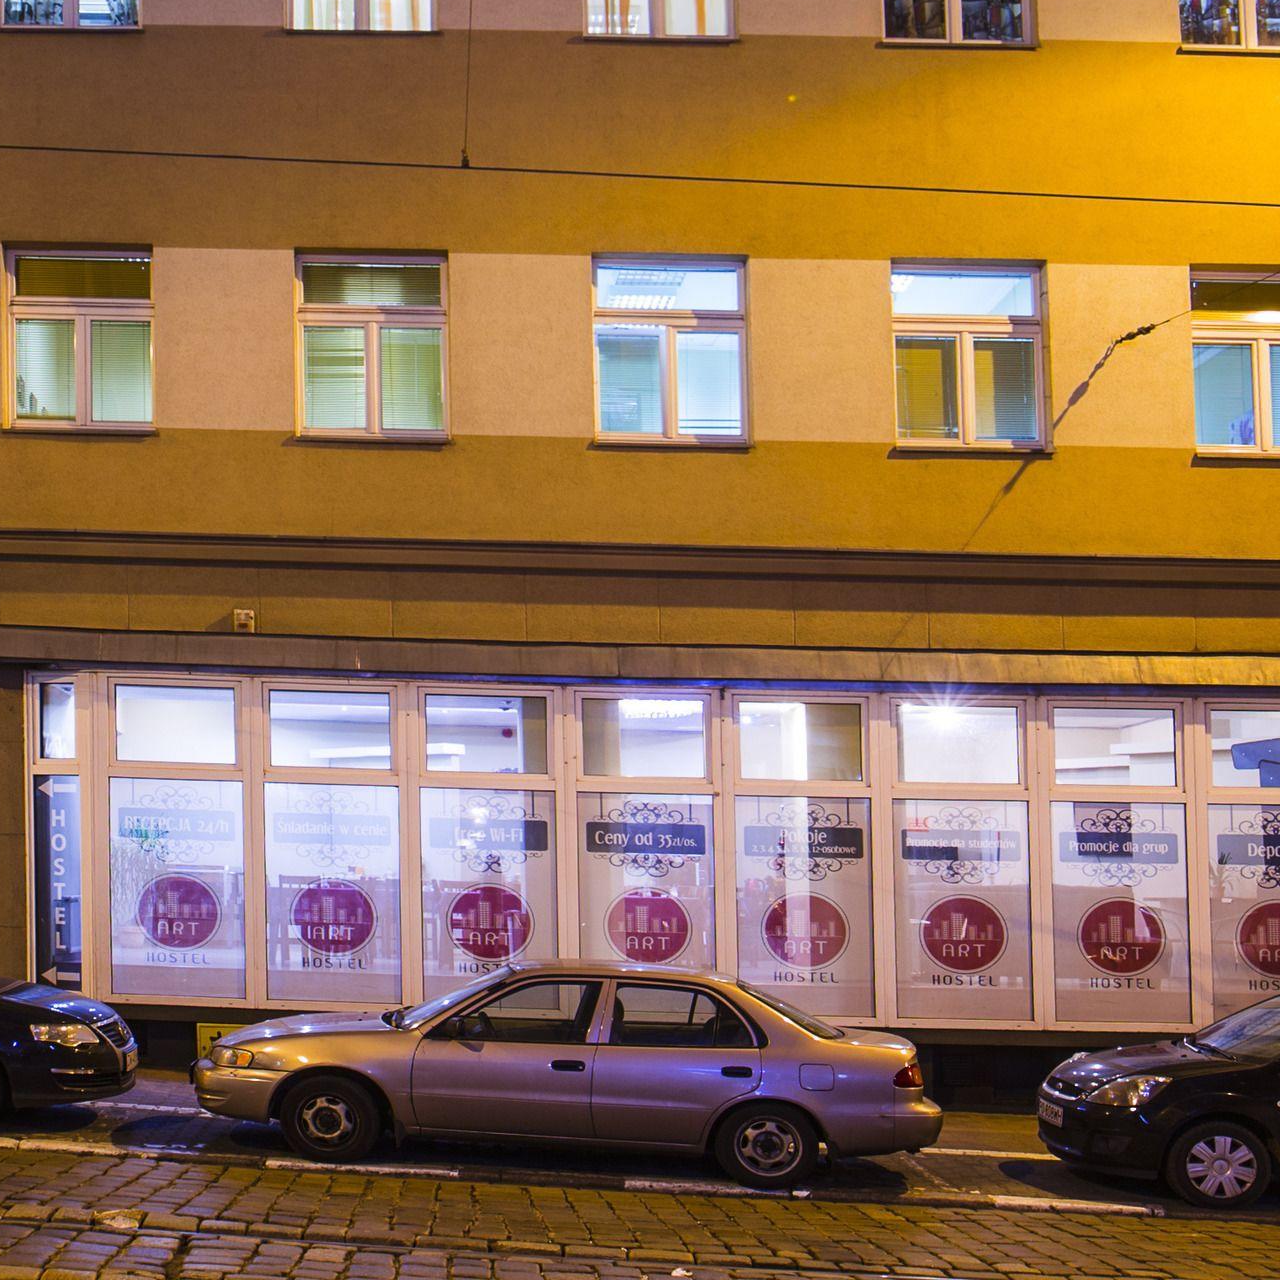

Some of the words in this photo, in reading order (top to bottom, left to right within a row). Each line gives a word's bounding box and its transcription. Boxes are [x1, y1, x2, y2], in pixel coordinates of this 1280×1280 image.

[489, 827, 524, 842] Wi-Fi
[594, 830, 630, 847] Ceny
[635, 832, 653, 846] od
[781, 829, 827, 845] Pokoje
[906, 837, 949, 848] Promocje
[951, 838, 965, 848] dla
[1069, 840, 1119, 853] Promocje
[1122, 841, 1139, 853] dla
[1142, 843, 1169, 854] grup
[51, 809, 67, 949] HOSTEL
[157, 919, 200, 937] ART
[469, 931, 512, 946] ART
[626, 935, 670, 950] ART
[784, 940, 828, 955] ART
[942, 943, 986, 958] ART
[1100, 946, 1143, 960] ART
[146, 952, 210, 965] HOSTEL
[302, 957, 367, 970] HOSTEL
[774, 971, 840, 984] HOSTEL
[932, 974, 998, 987] HOSTEL
[1090, 977, 1156, 990] HOSTEL
